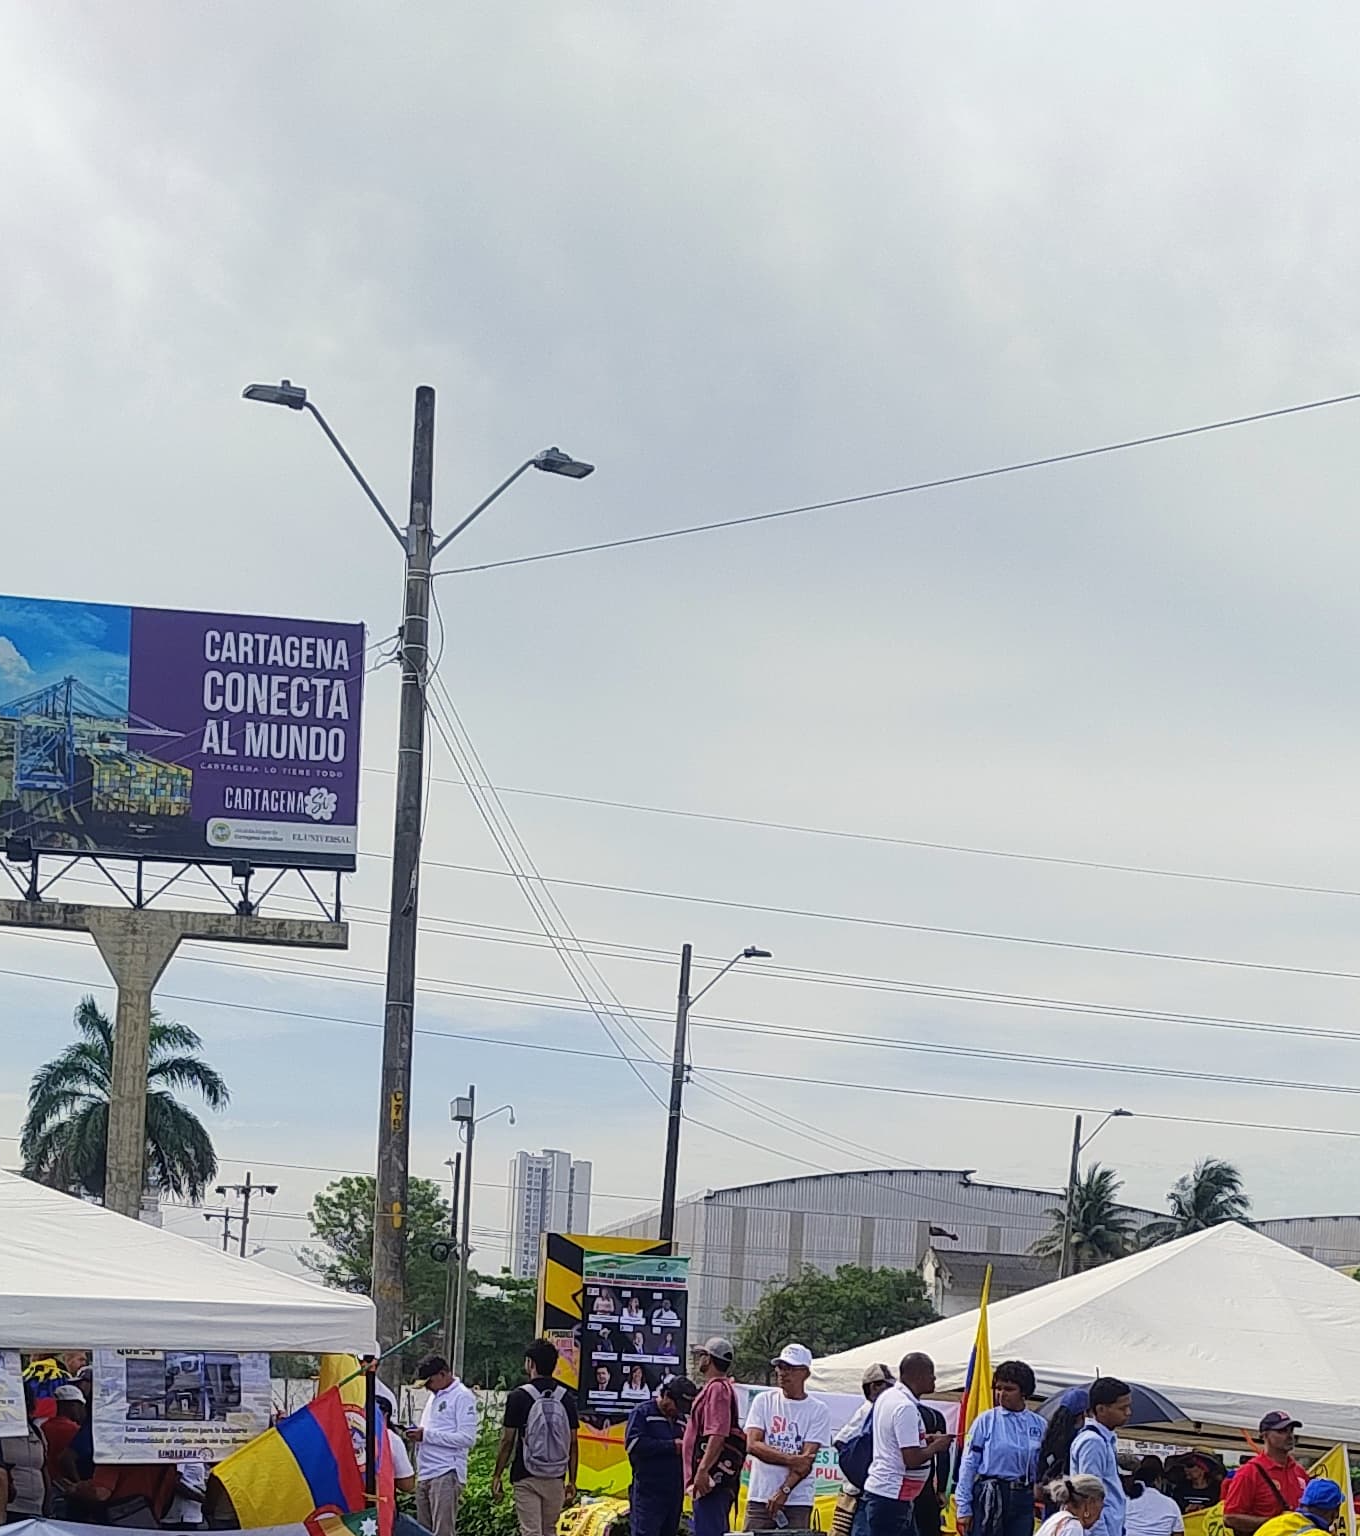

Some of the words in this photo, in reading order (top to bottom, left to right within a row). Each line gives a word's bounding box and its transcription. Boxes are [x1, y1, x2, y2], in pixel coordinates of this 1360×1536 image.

[204, 630, 350, 671] CARTAGENA
[202, 670, 350, 720] CONECTA
[201, 718, 237, 756] AL
[244, 721, 346, 763] MUNDO
[224, 787, 305, 814] CARTAGENA
